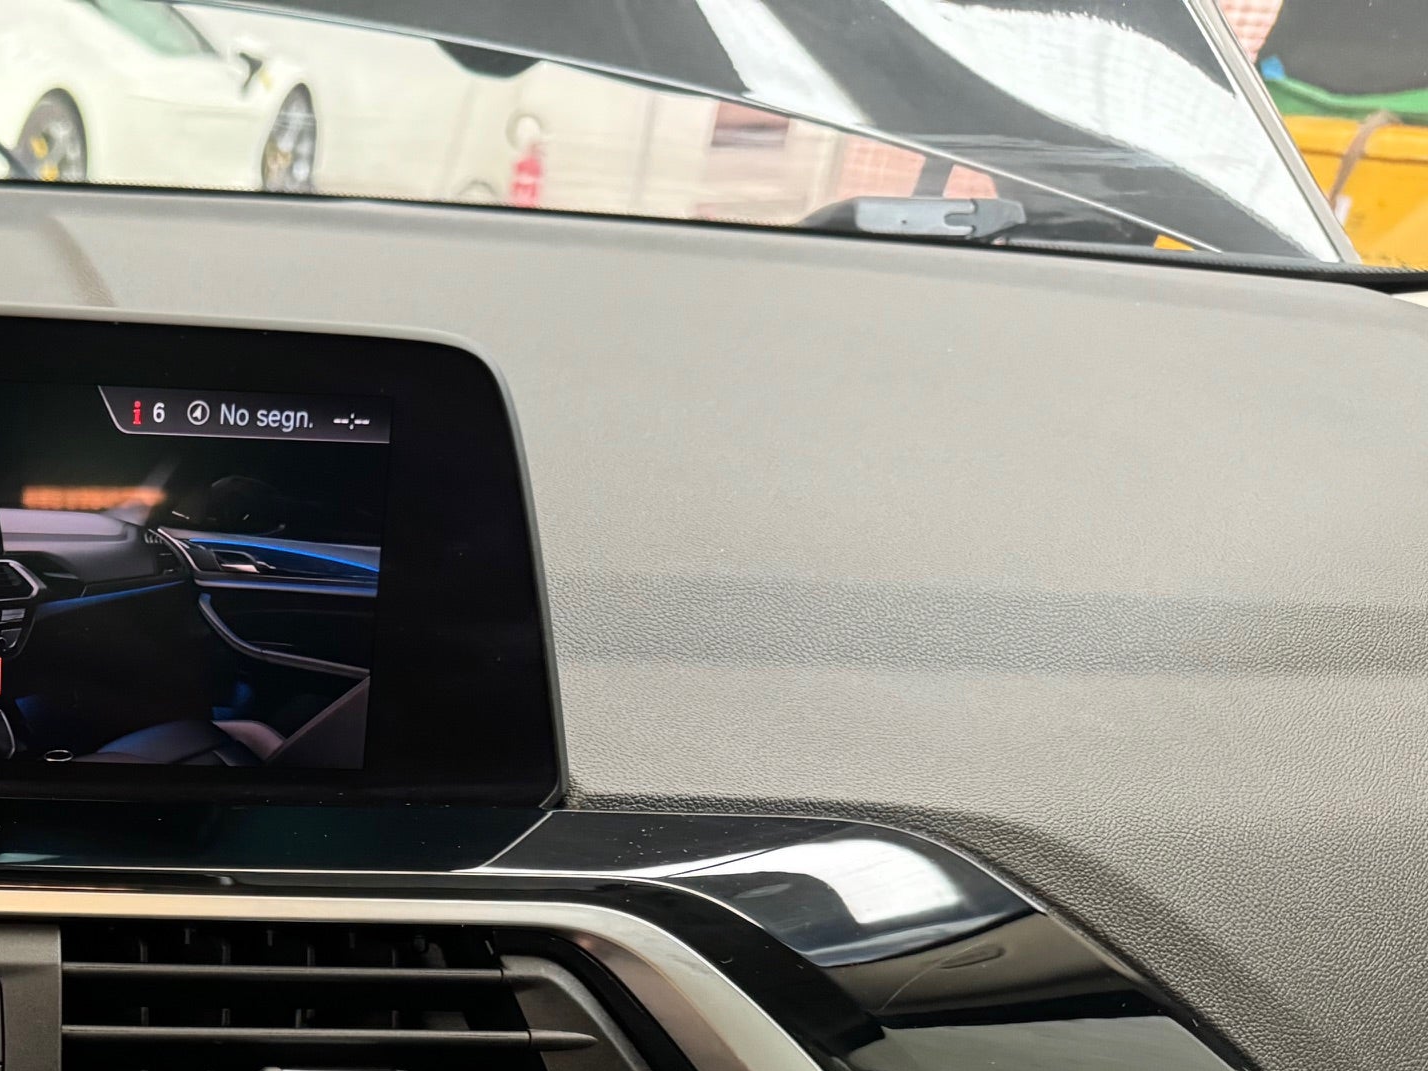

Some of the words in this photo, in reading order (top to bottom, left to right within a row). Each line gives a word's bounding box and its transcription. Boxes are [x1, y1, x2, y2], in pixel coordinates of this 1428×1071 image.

[152, 402, 166, 423] 6
[219, 403, 250, 427] No
[256, 408, 314, 432] segn.
